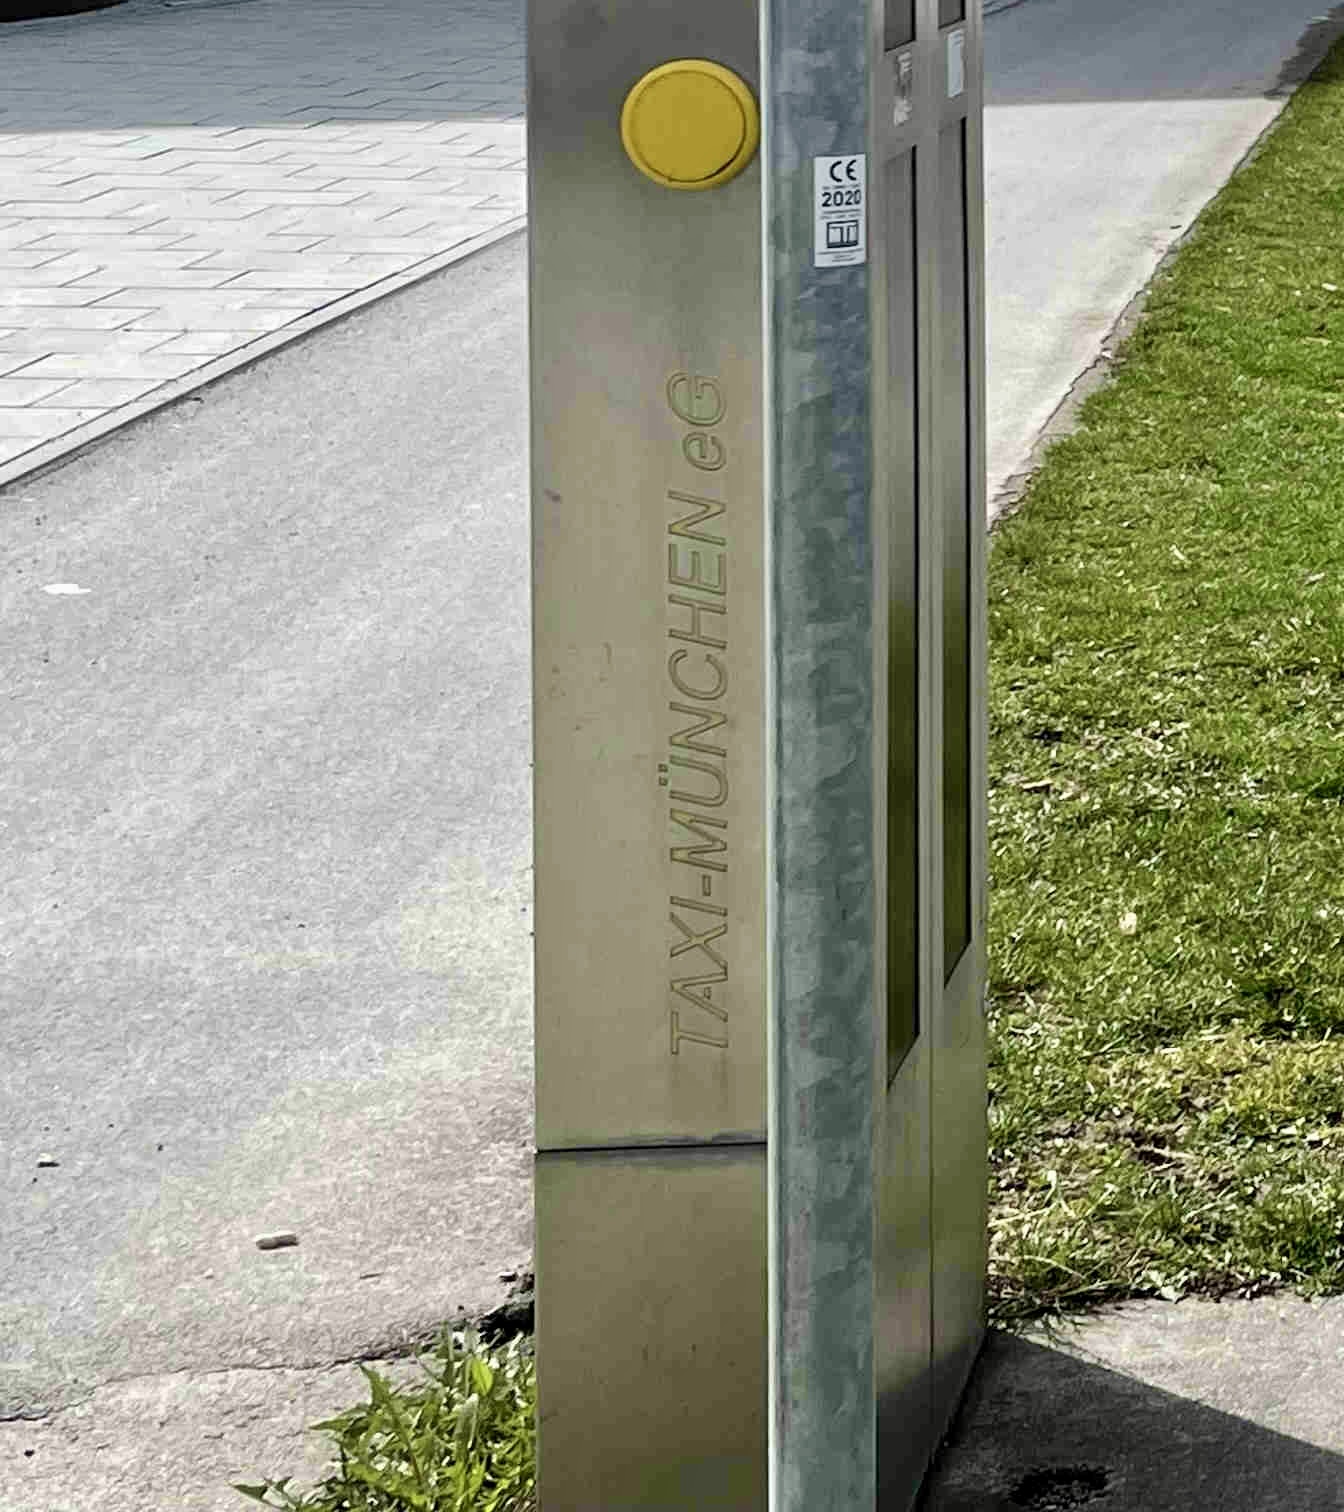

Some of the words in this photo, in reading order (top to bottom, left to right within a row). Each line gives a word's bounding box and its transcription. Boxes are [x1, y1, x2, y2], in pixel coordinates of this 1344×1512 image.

[822, 189, 862, 207] 2020
[666, 369, 726, 472] eG
[659, 489, 729, 1055] TAXI-MÜNCHEN
